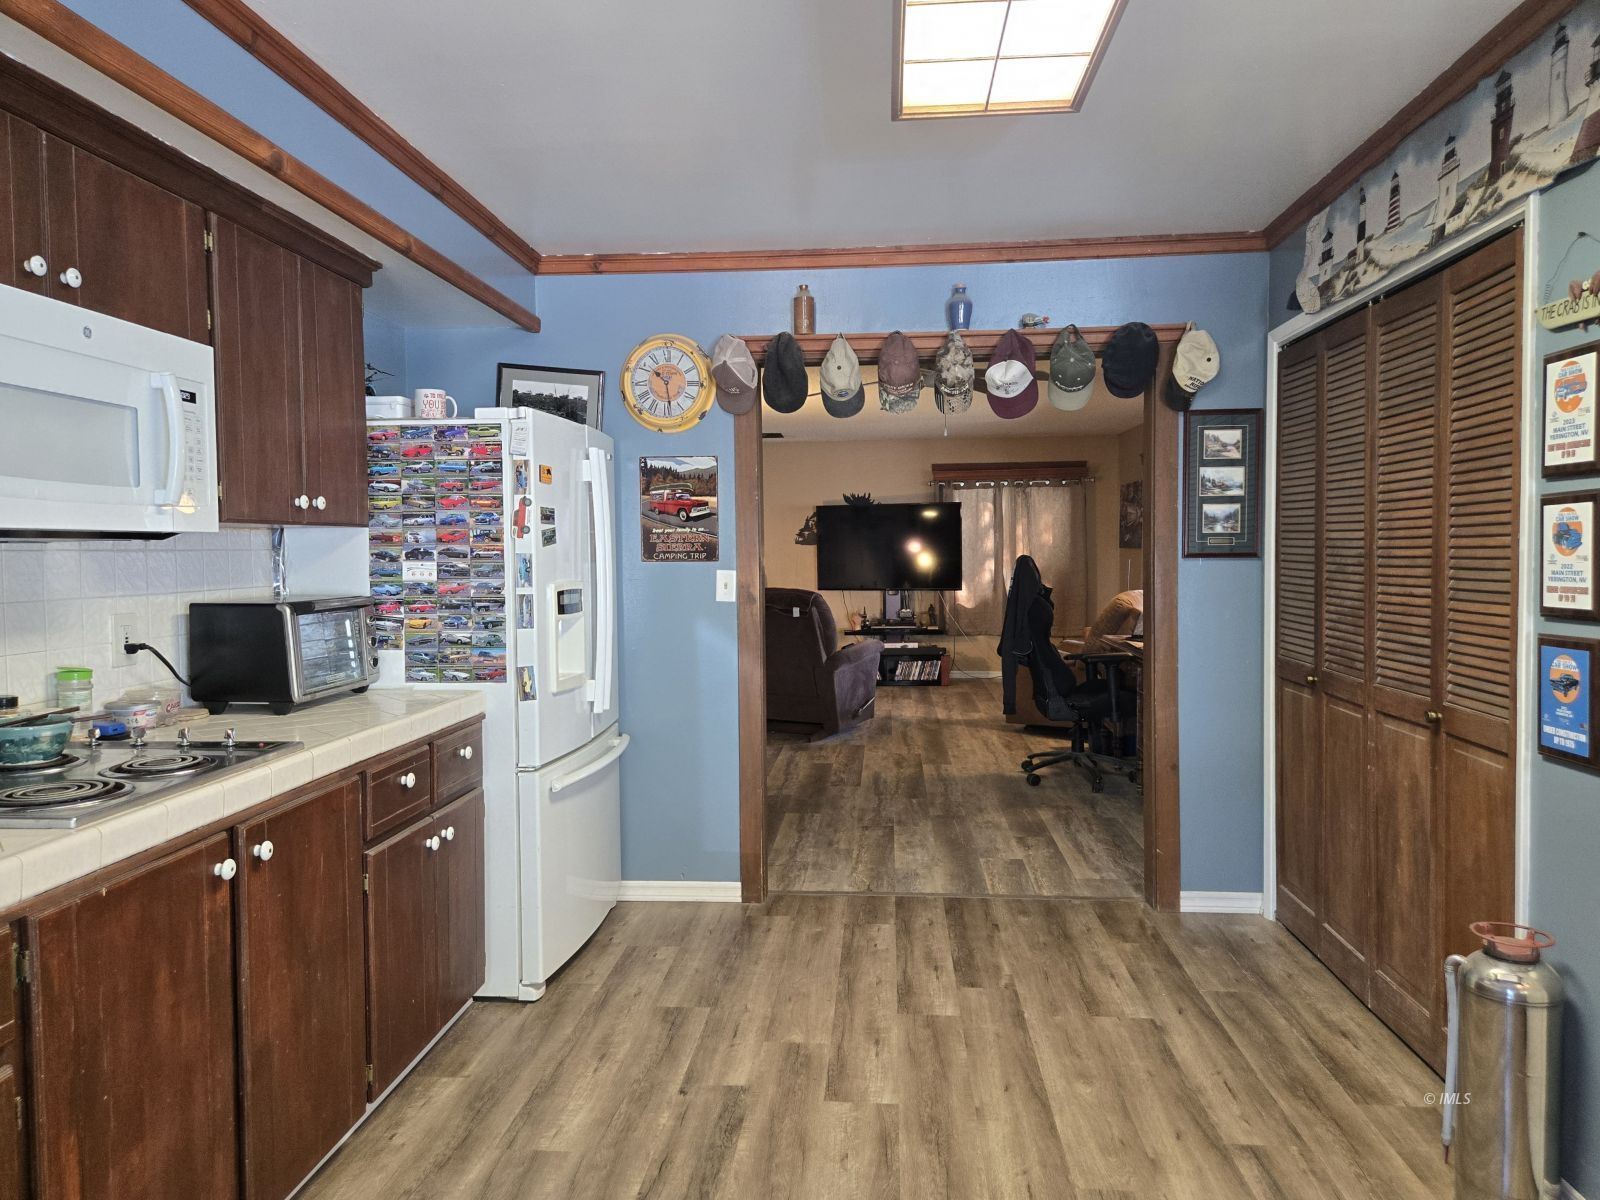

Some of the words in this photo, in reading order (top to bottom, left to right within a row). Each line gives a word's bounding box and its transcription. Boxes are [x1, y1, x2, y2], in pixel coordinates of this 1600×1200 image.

[1541, 304, 1556, 321] THE
[1557, 298, 1580, 318] CRAB
[1581, 294, 1590, 311] IS
[422, 399, 440, 410] YOU
[649, 533, 710, 543] EASTERN
[690, 552, 707, 560] TRIP
